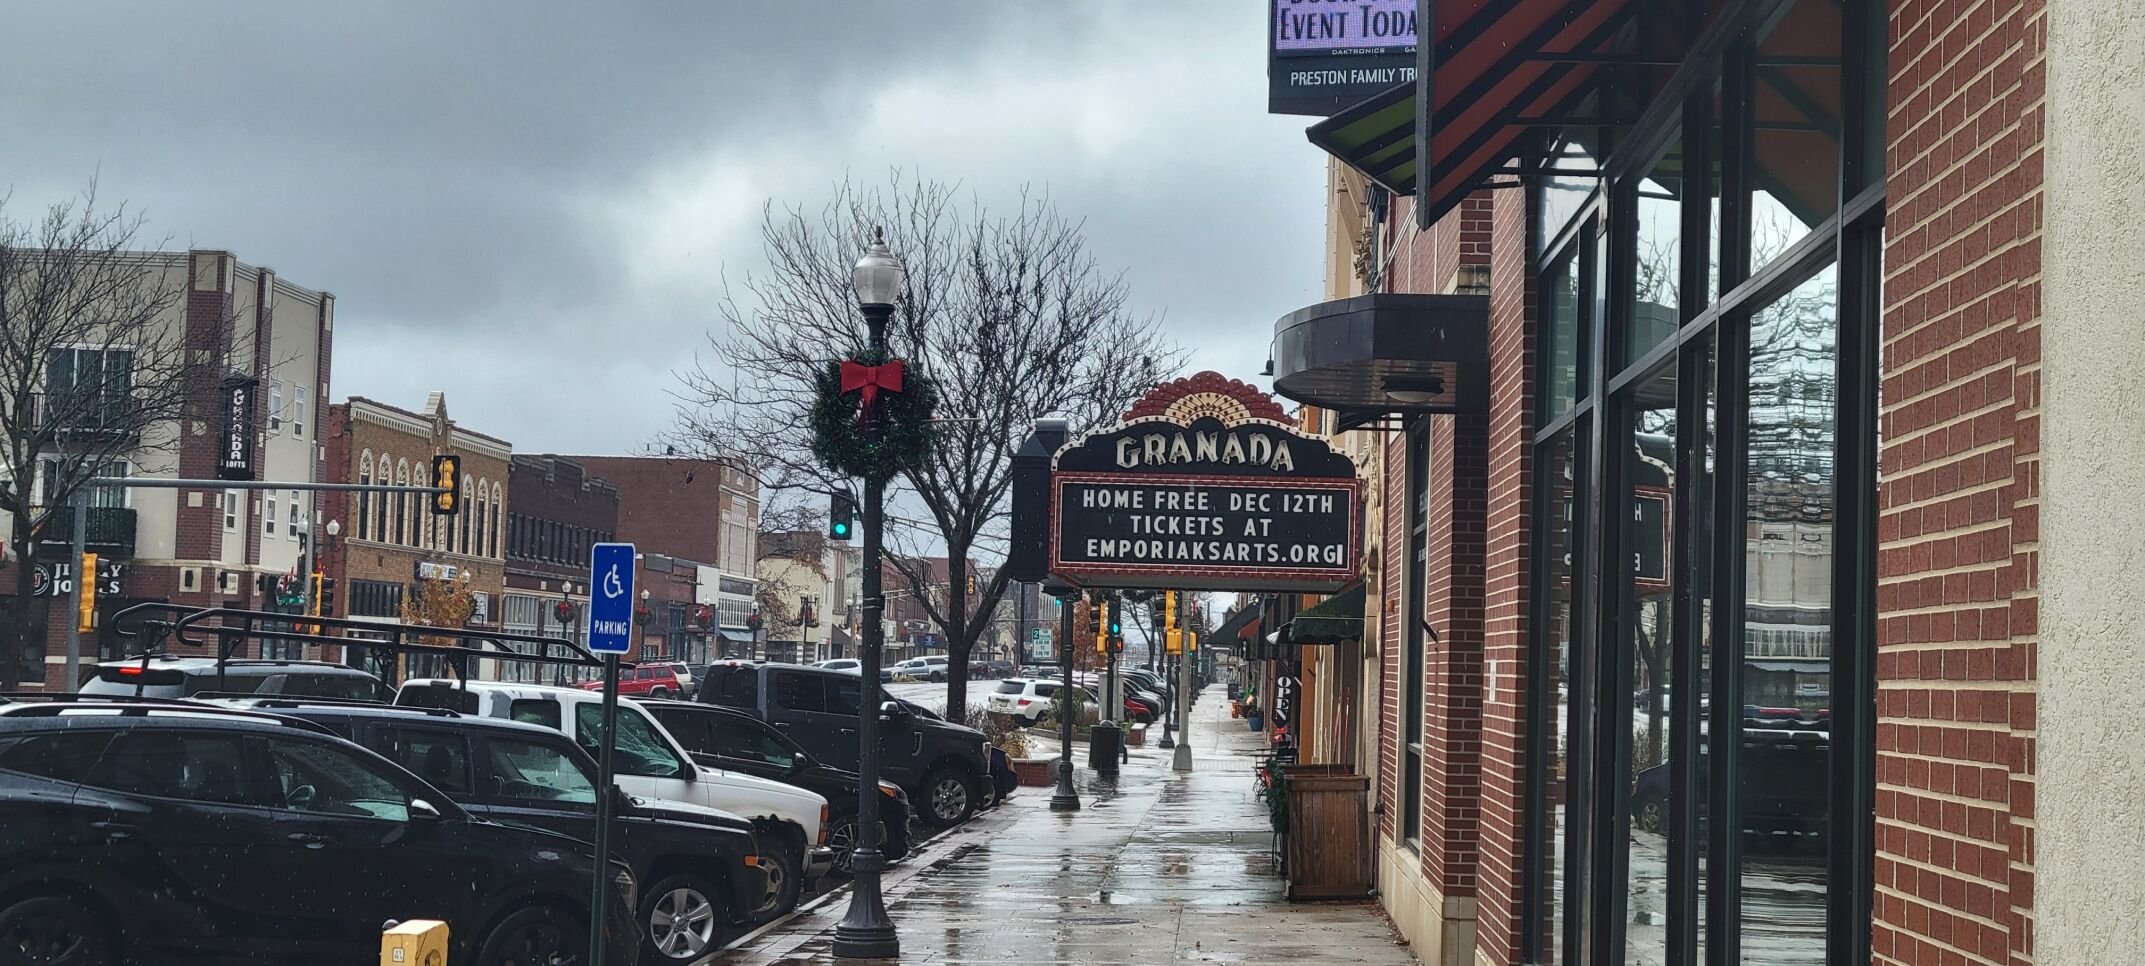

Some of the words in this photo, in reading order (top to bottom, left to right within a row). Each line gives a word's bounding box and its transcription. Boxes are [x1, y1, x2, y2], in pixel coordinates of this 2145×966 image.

[1281, 8, 1349, 40] EVENT
[1332, 47, 1385, 55] DAKTRONICS
[1290, 71, 1347, 86] PRESTON
[1351, 68, 1396, 84] FAMILY
[1116, 430, 1295, 472] GRANADA
[226, 460, 246, 468] LOFTS
[1083, 489, 1144, 509] HOME
[1154, 490, 1209, 511] FREE
[1230, 492, 1271, 512] DEC
[1283, 494, 1333, 513] 12TH
[1130, 515, 1224, 535] TICKETS
[1243, 518, 1273, 537] AT
[594, 619, 627, 636] PARKING
[1033, 630, 1039, 639] 2
[1275, 676, 1291, 720] OPEN
